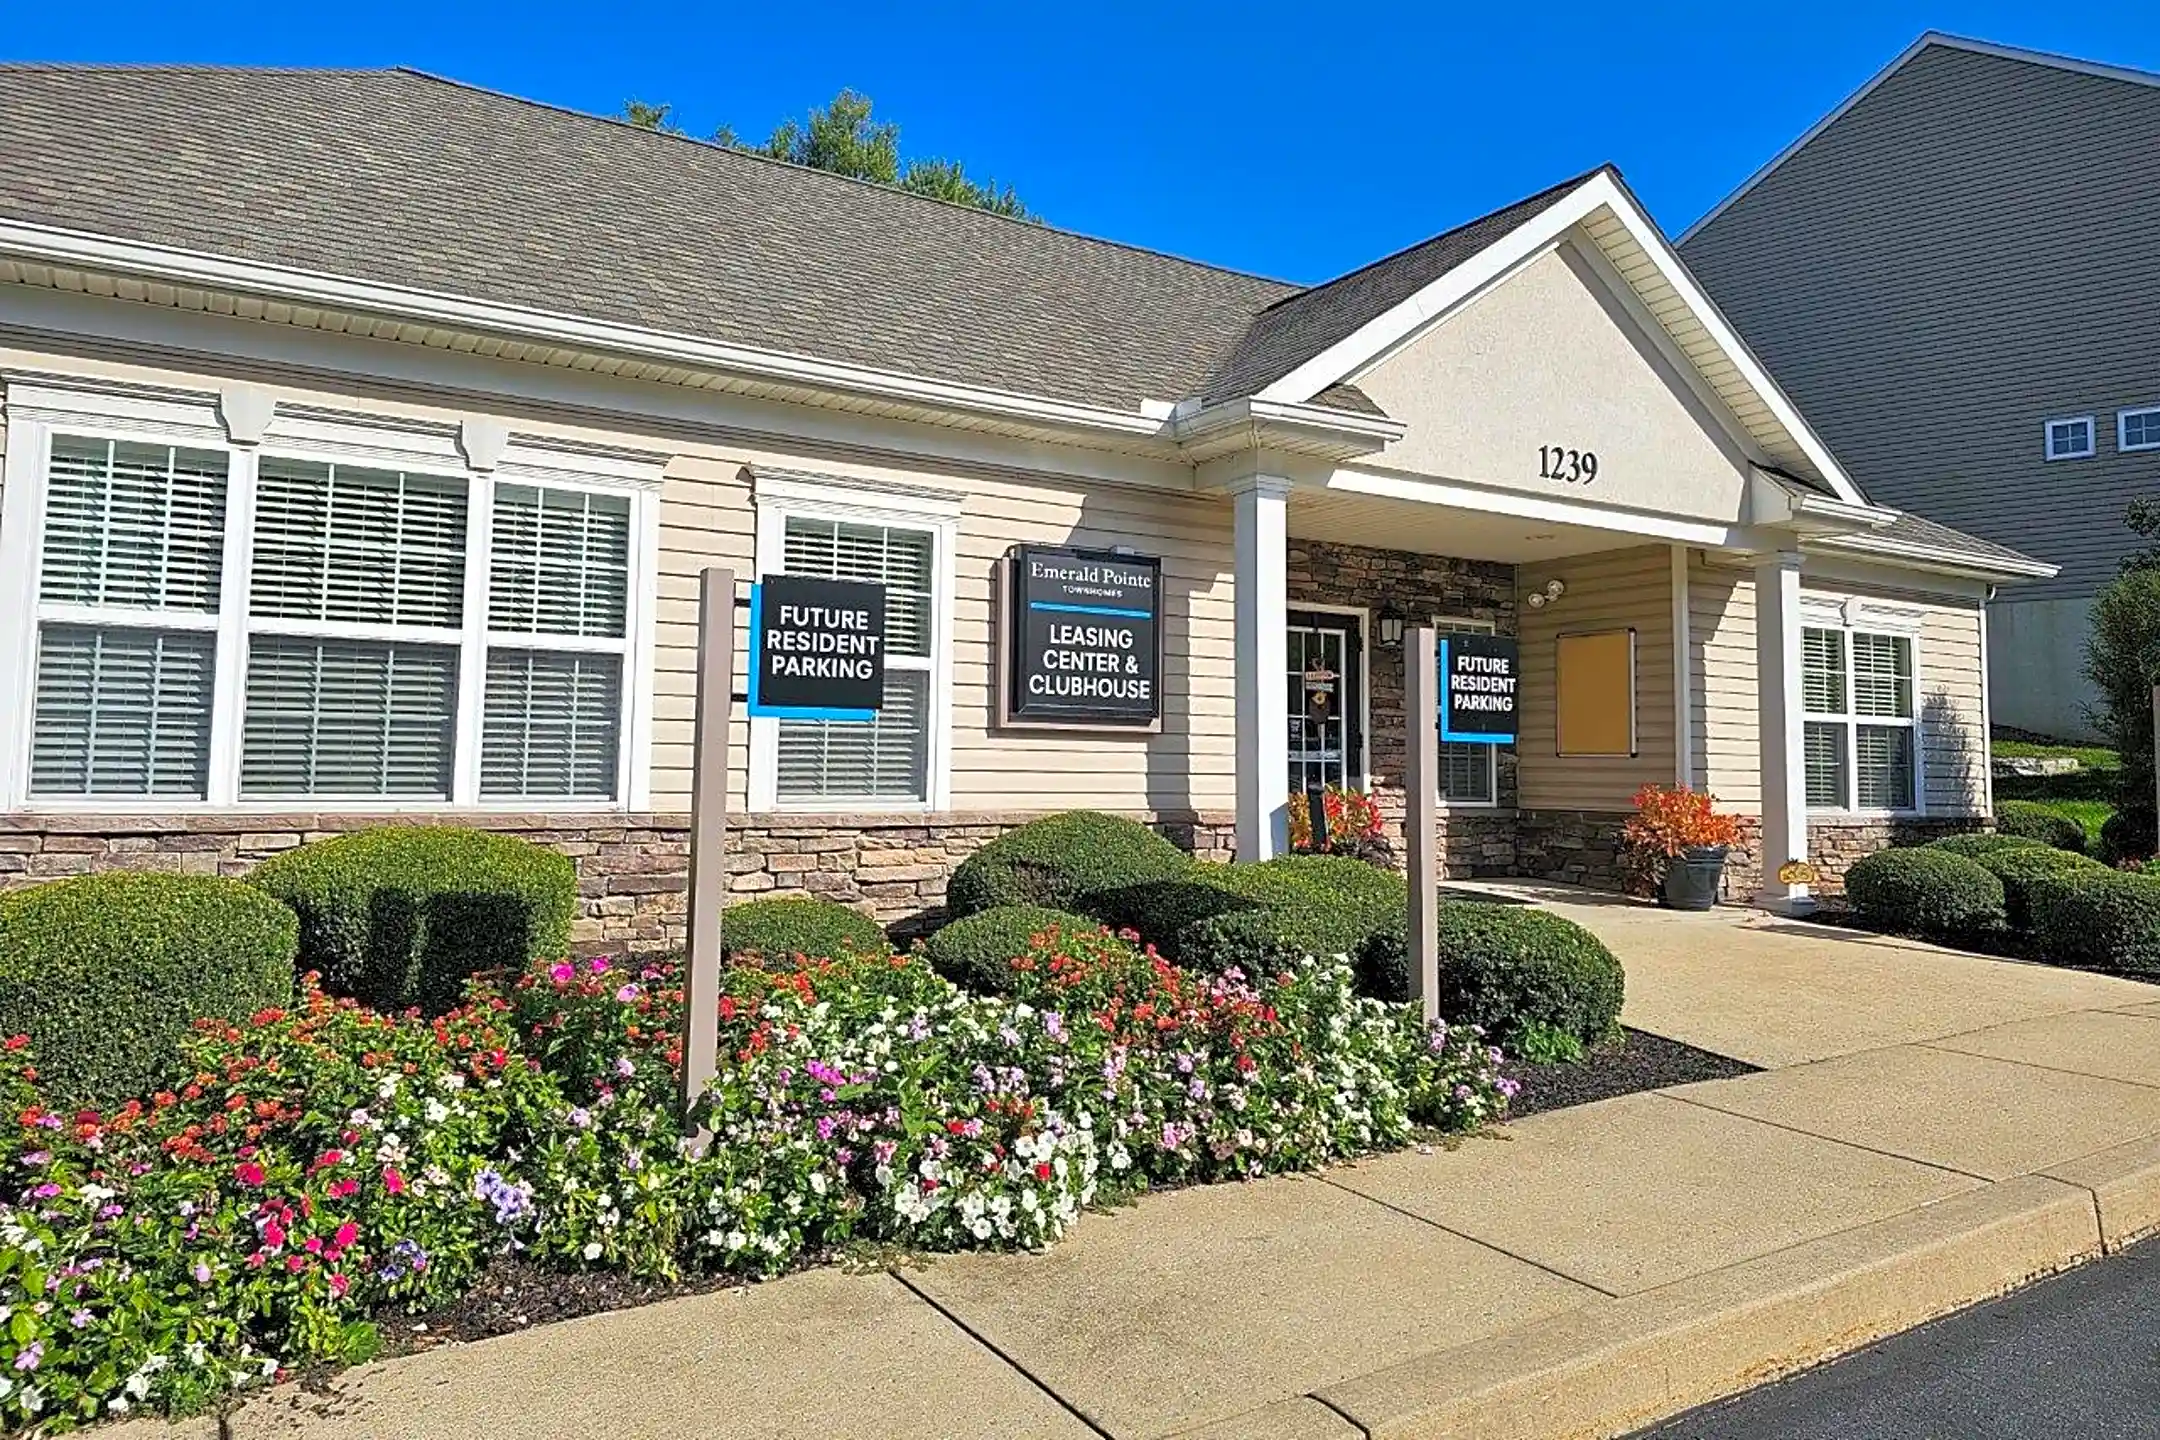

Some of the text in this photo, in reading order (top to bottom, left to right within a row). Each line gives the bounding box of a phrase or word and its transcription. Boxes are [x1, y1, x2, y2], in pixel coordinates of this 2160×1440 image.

[1538, 445, 1598, 485] 1239
[1031, 562, 1152, 588] Emerald Pointe
[1062, 585, 1123, 598] TOWNHOMES
[780, 605, 869, 630] FUTURE
[767, 629, 880, 655] RESIDENT
[1050, 624, 1133, 649] LEASING
[772, 655, 873, 679] PARKING
[1043, 649, 1139, 674] CENTER &
[1457, 656, 1510, 674] FUTURE
[1029, 674, 1151, 699] CLUBHOUSE
[1451, 674, 1516, 693] RESIDENT
[1454, 694, 1513, 712] PARKING
